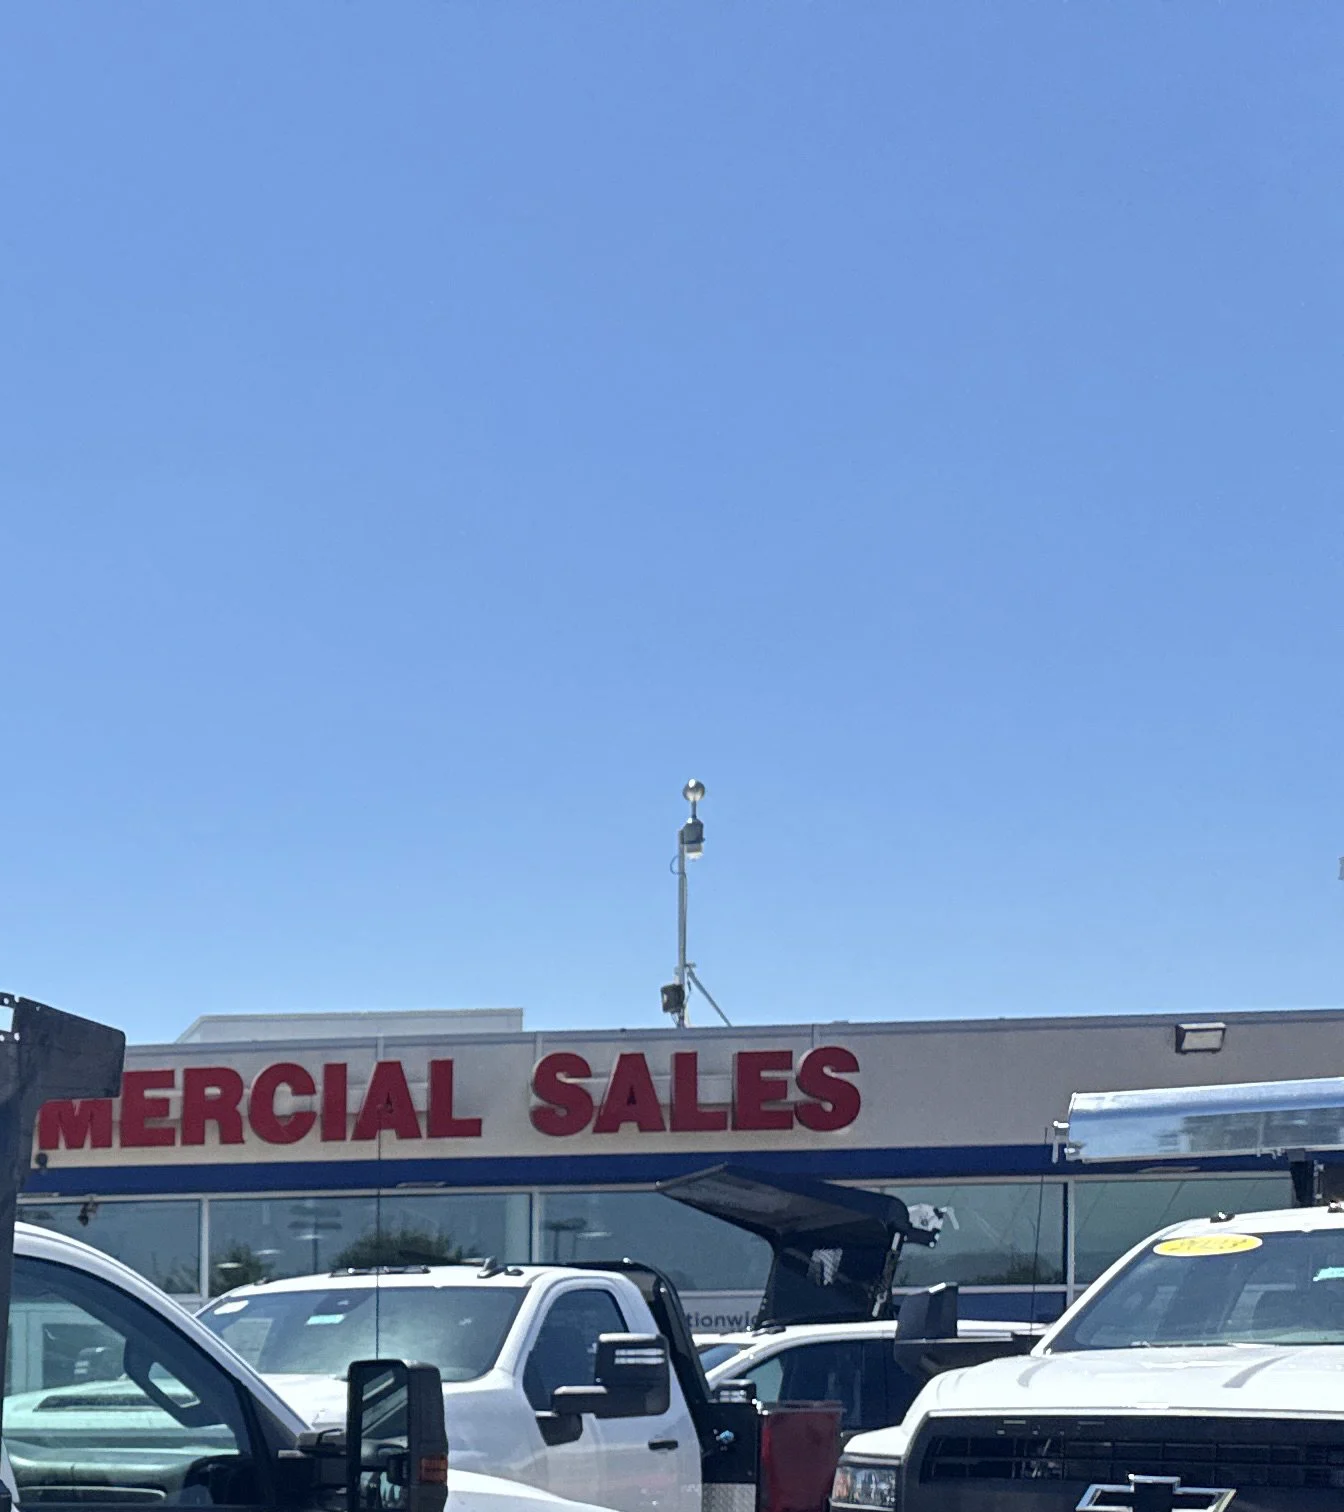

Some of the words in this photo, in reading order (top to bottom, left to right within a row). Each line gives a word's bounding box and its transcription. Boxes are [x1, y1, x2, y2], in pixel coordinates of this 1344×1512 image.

[37, 1059, 482, 1150] MERCIAL
[530, 1046, 861, 1136] SALES
[685, 1310, 758, 1328] tionwi
